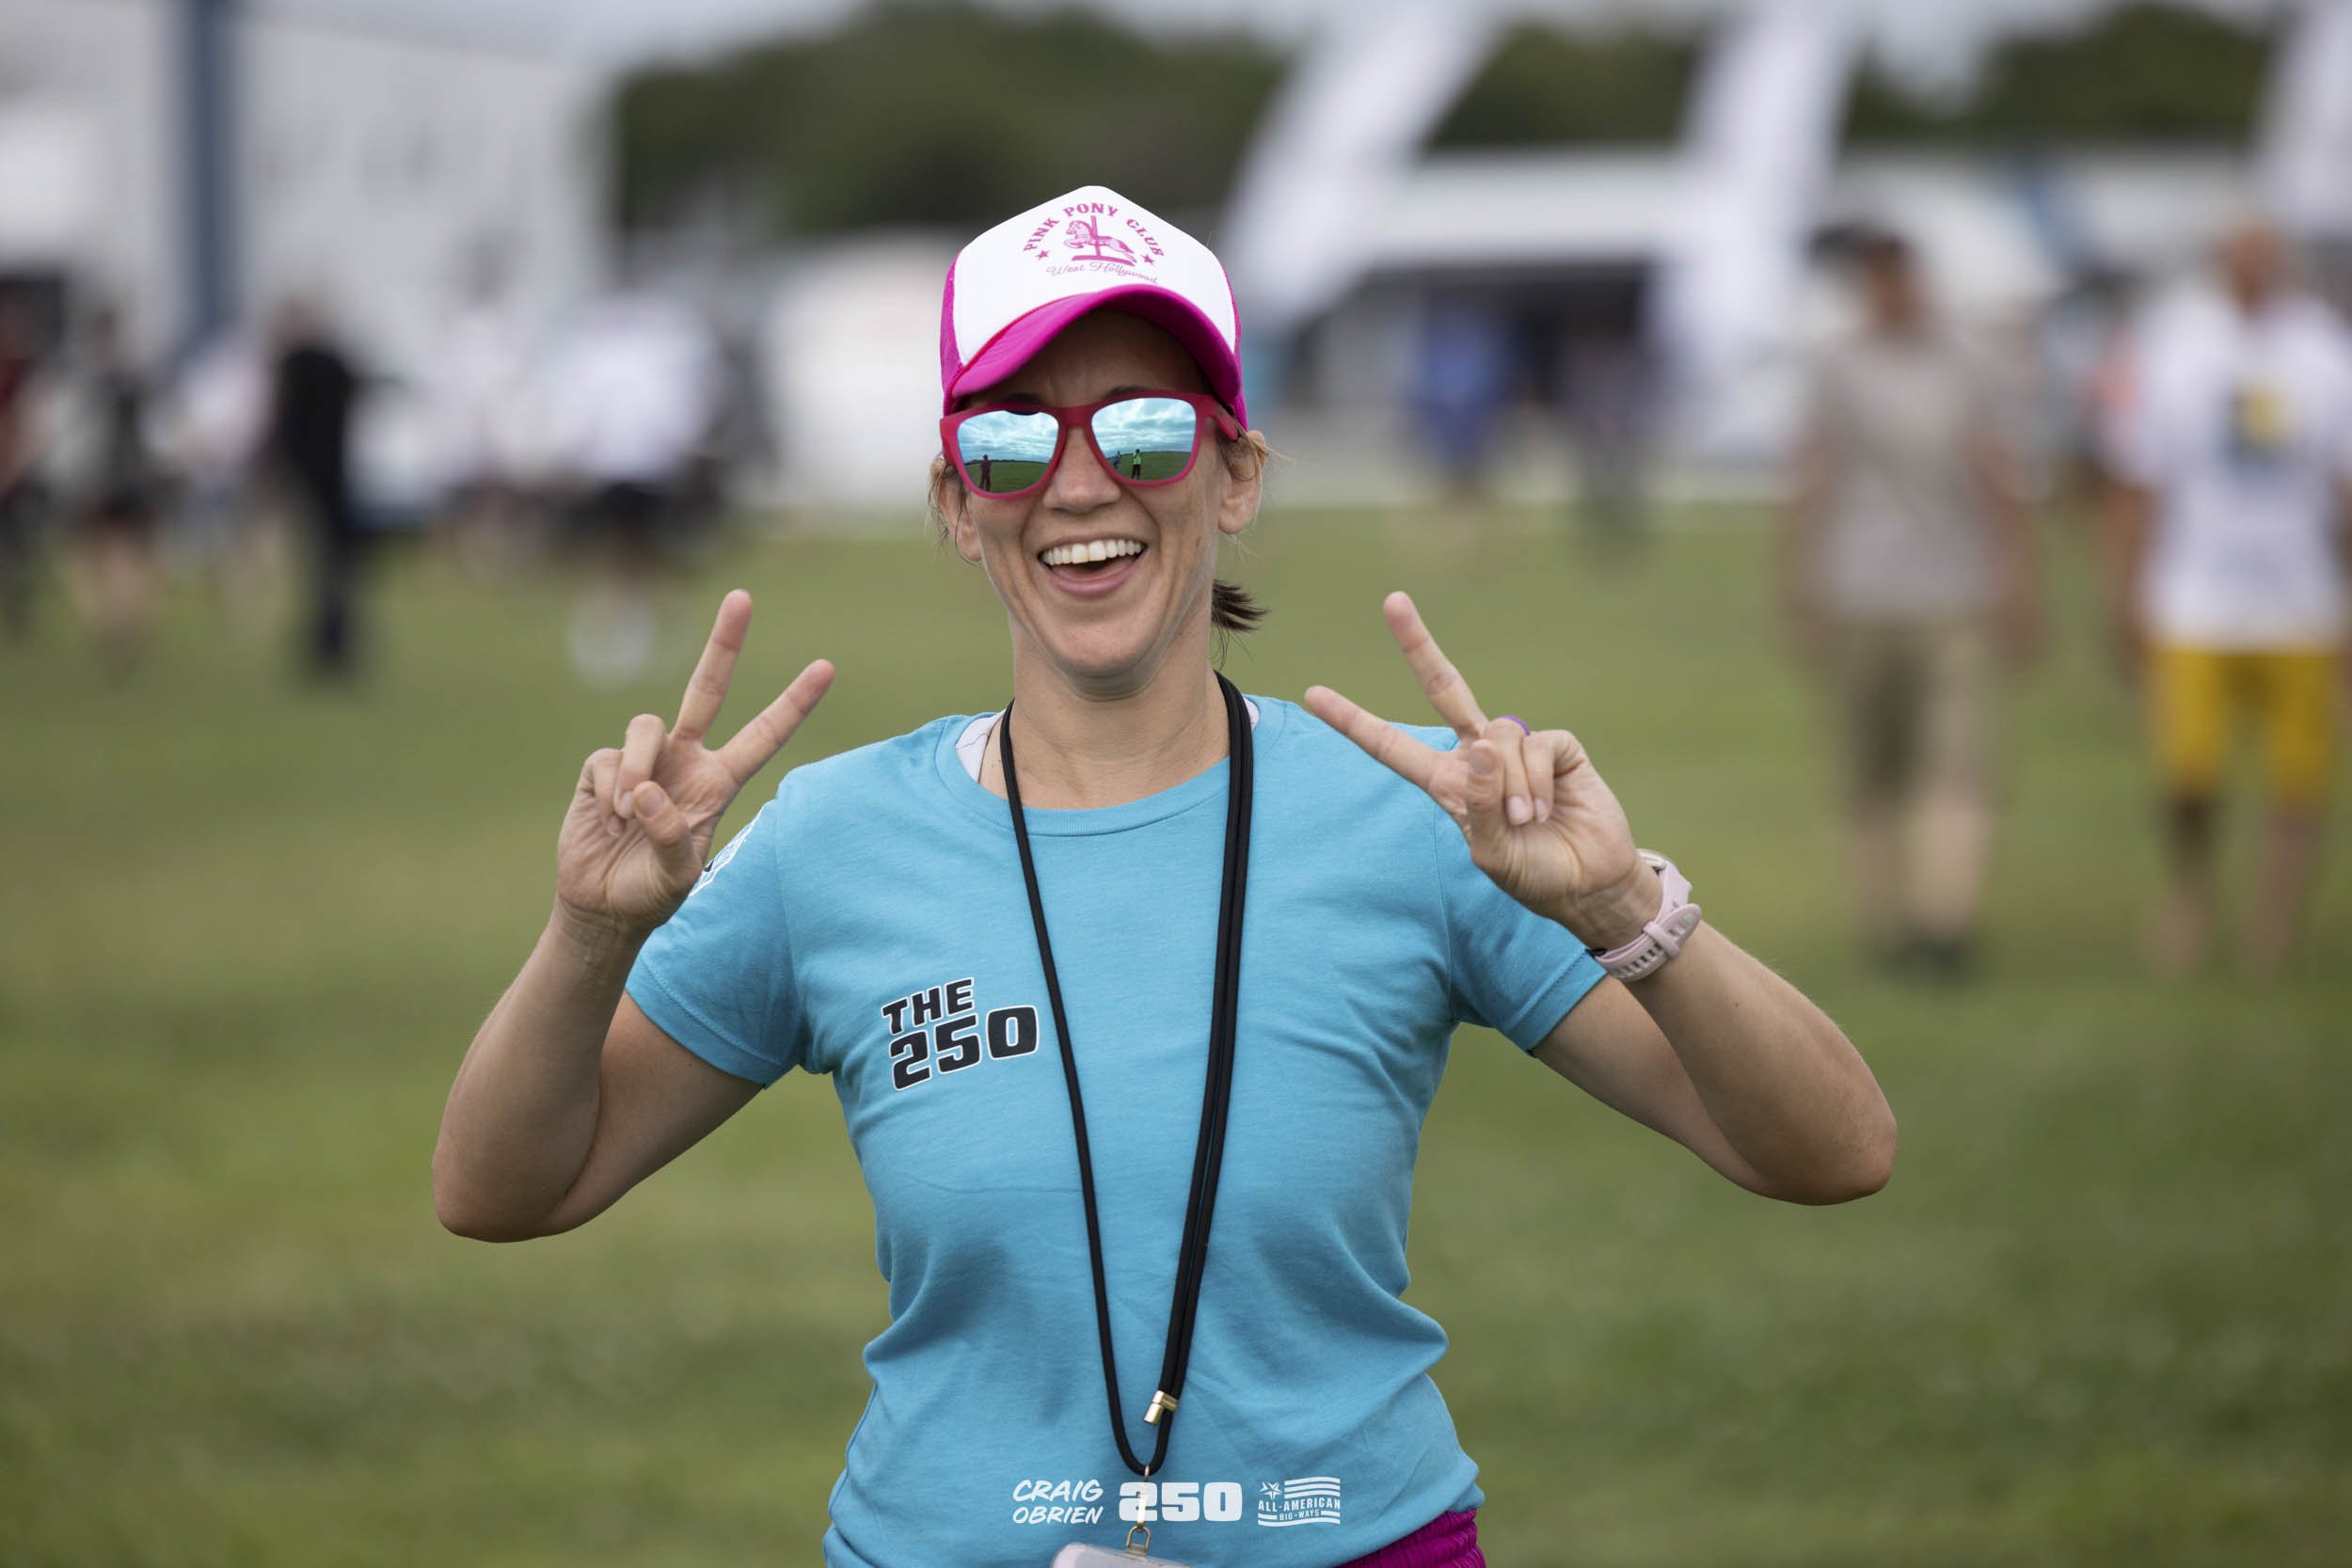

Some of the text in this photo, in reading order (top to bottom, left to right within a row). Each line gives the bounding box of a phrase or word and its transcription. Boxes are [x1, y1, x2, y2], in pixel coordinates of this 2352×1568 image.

[1023, 202, 1166, 257] PINK PONY CLUB
[1046, 263, 1086, 277] West
[881, 976, 975, 1036] THE
[889, 1005, 1040, 1091] 250
